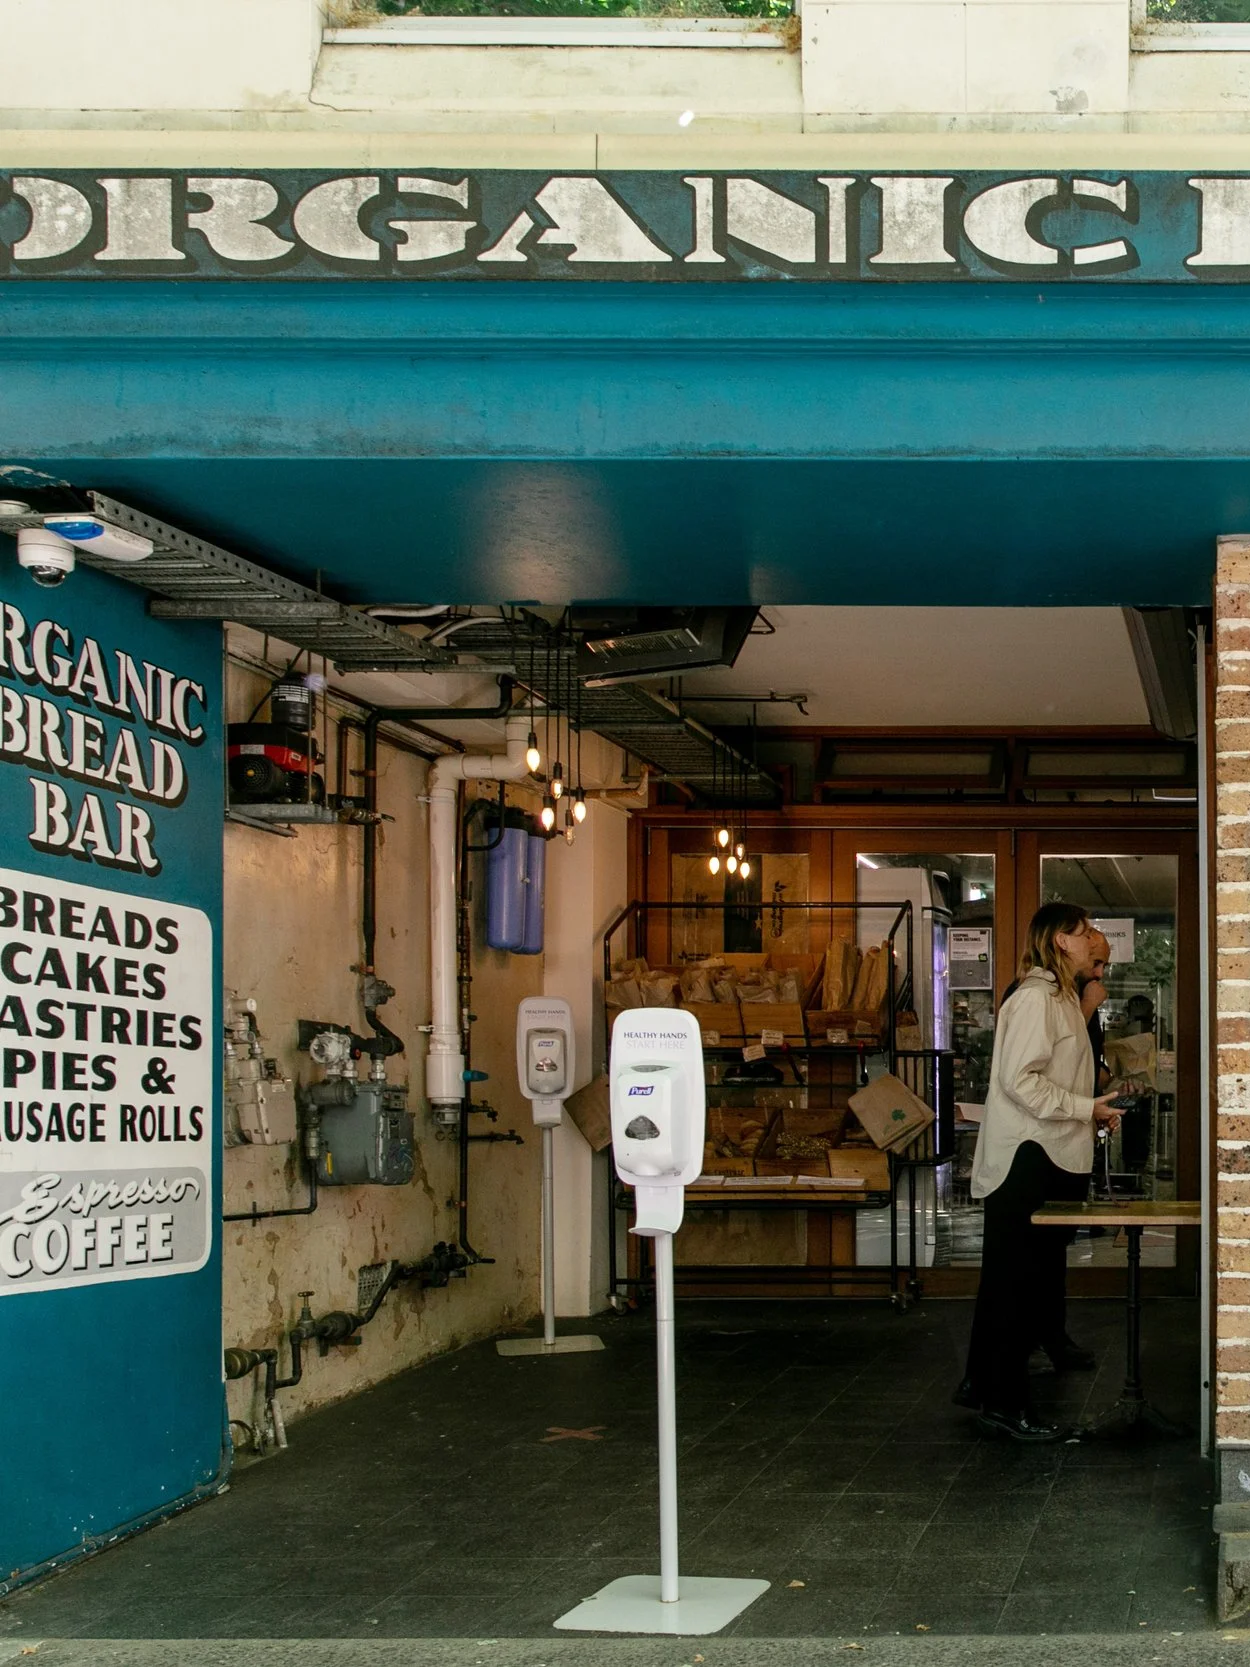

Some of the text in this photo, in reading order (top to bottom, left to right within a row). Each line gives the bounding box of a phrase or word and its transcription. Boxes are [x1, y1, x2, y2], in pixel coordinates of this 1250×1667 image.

[28, 776, 158, 869] BAR
[0, 886, 179, 955] BREADS
[0, 941, 167, 1001] CAKES
[623, 1031, 689, 1039] HEALTHY HANDS
[626, 1040, 686, 1049] START HERE
[2, 1047, 176, 1095] PIES &
[0, 1101, 204, 1143] USAGE ROLLS
[0, 1173, 200, 1226] Espresso
[0, 1212, 174, 1279] COFFEE
